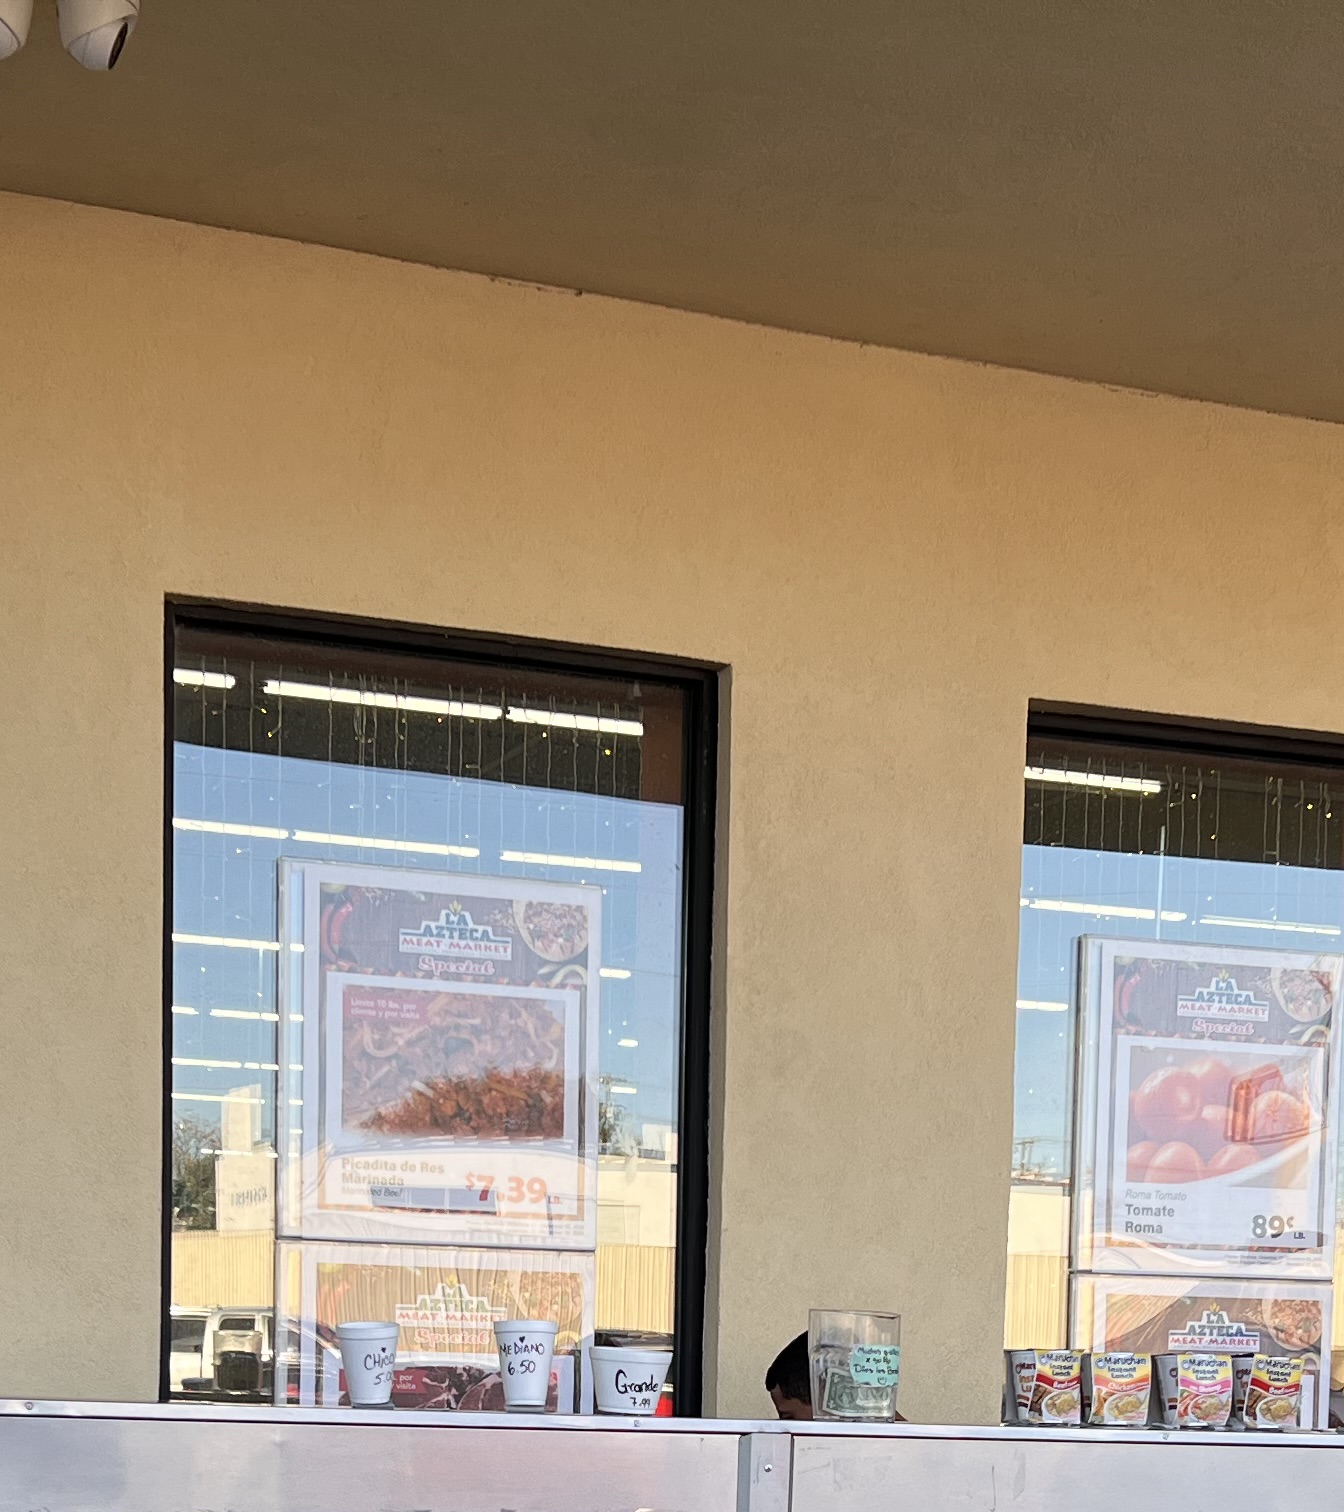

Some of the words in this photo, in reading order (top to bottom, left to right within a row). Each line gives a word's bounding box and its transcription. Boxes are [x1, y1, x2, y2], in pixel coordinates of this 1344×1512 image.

[446, 912, 469, 926] LA
[422, 924, 492, 942] AZTECA
[401, 937, 443, 948] MEAT
[449, 942, 510, 954] MARKET
[418, 955, 495, 976] Special
[1196, 991, 1254, 1005] AZTECA
[1179, 1003, 1213, 1012] MEAT
[342, 1158, 397, 1173] Picadita
[401, 1160, 417, 1173] de
[421, 1161, 444, 1174] Res
[342, 1172, 404, 1186] Marinada
[465, 1172, 548, 1204] $7.39
[1125, 1189, 1152, 1200] Roma
[1155, 1190, 1187, 1201] Tomato
[1125, 1204, 1175, 1217] Tomate
[1125, 1221, 1163, 1234] Roma
[1187, 1324, 1246, 1337] AZTECA
[1170, 1337, 1205, 1345] MEAT
[1208, 1338, 1258, 1347] MARKET
[1105, 1356, 1146, 1365] Maruchan
[1189, 1358, 1228, 1368] Maruchan
[507, 1360, 536, 1376] 6.50
[615, 1369, 659, 1394] Grande
